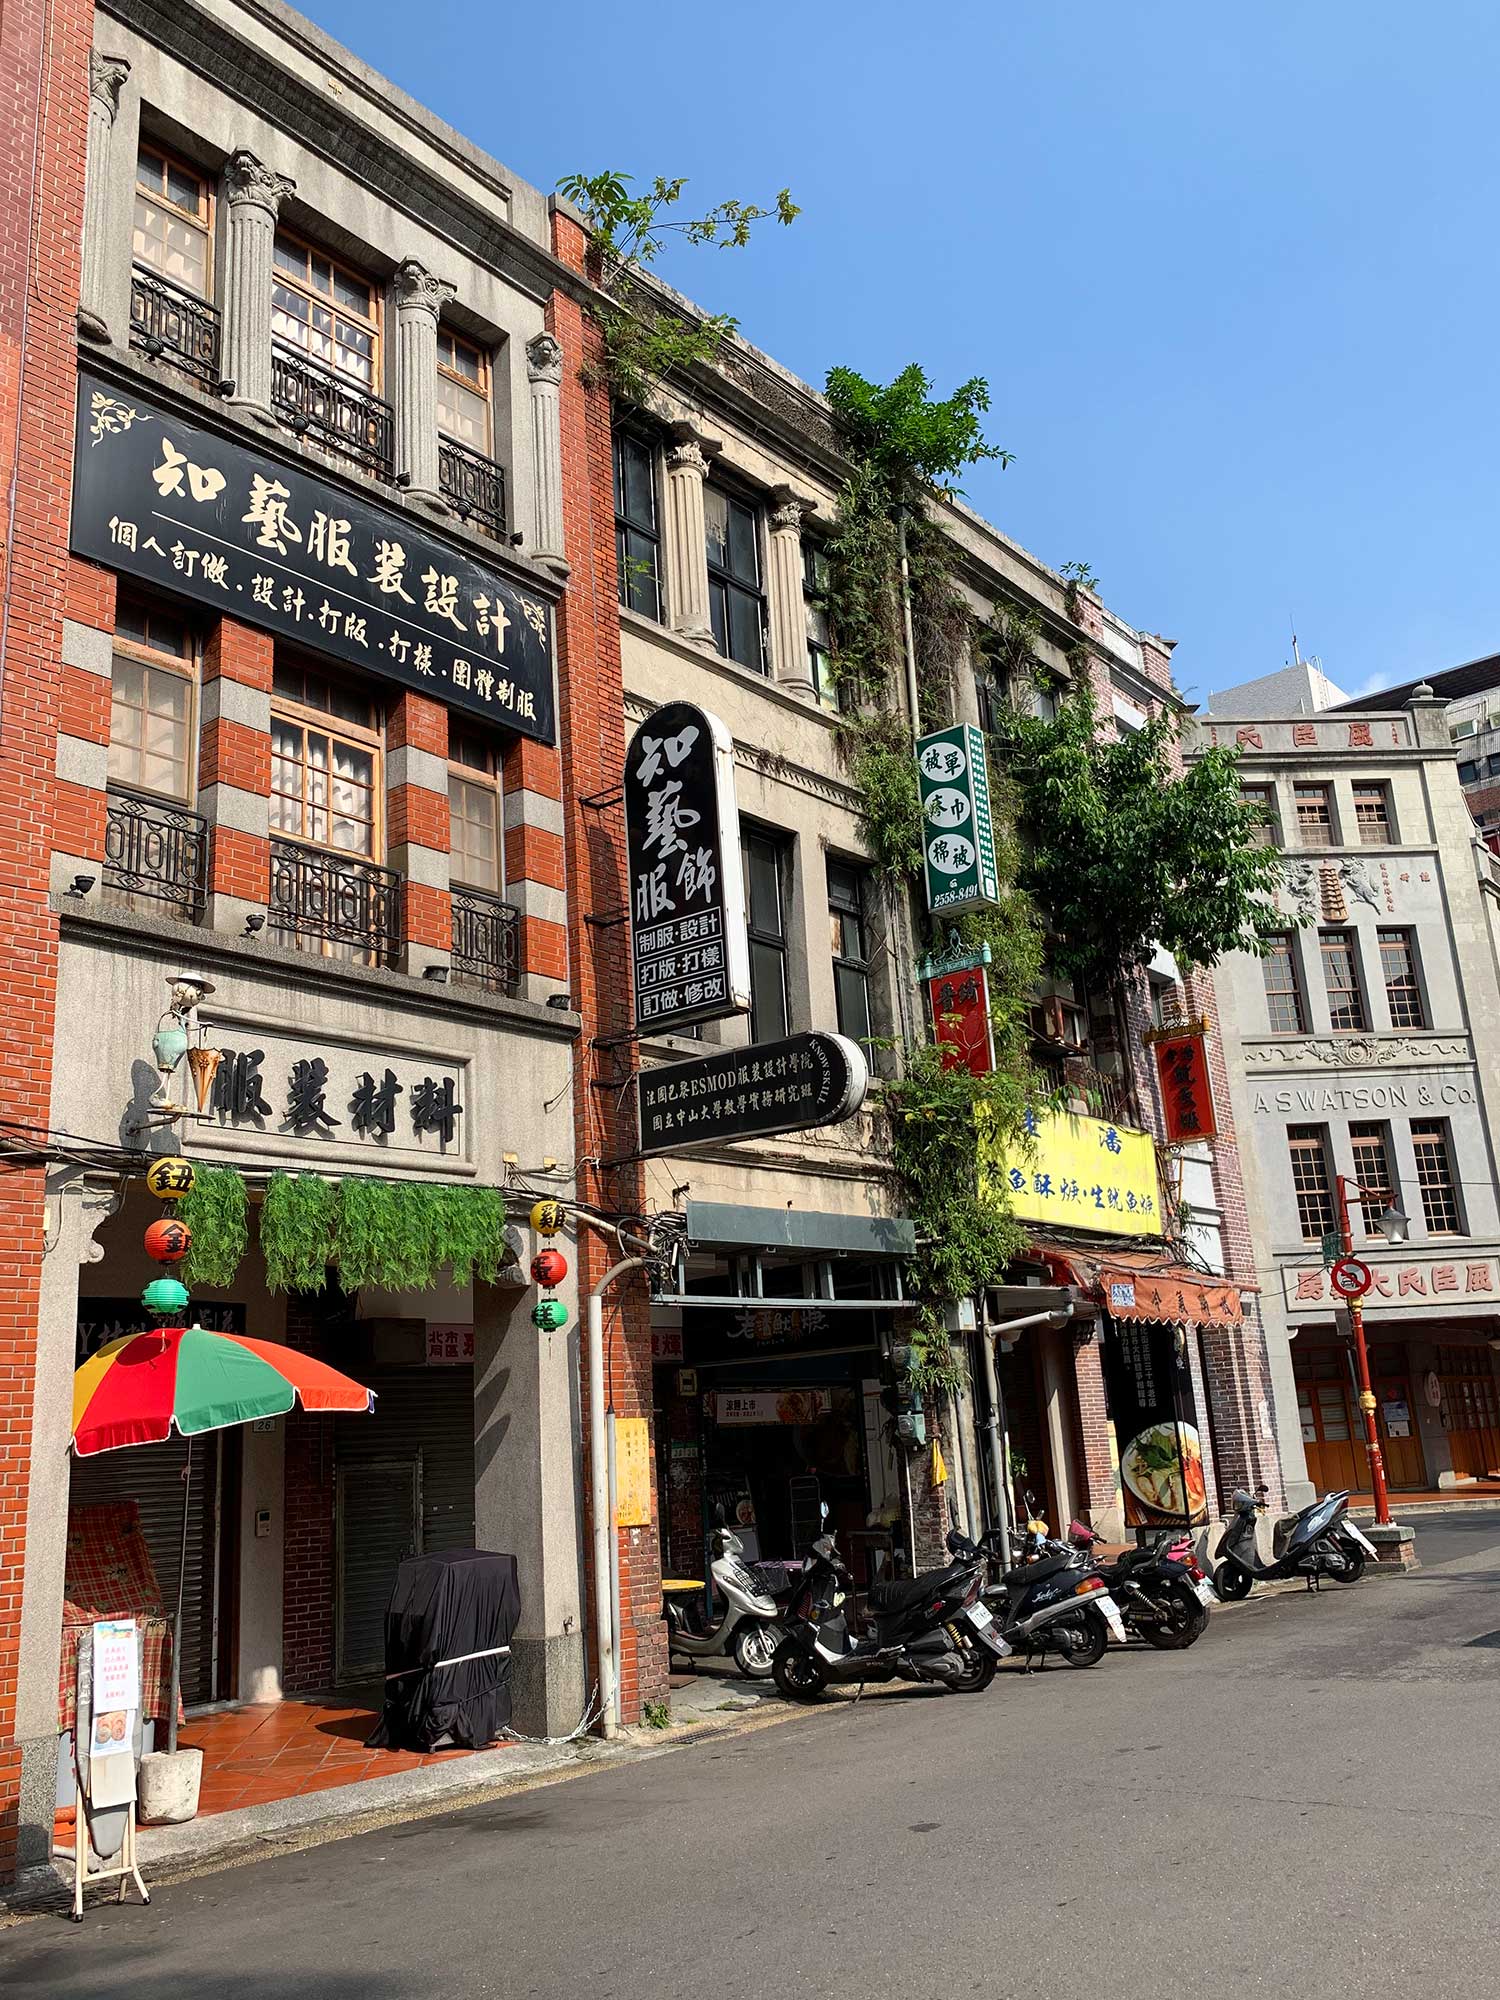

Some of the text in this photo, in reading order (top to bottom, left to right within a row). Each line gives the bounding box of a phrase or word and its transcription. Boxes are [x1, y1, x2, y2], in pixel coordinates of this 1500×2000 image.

[152, 437, 512, 654] 知藝服裝設計
[925, 749, 961, 776] 被單
[933, 840, 971, 868] 棉被
[934, 883, 978, 908] 2558-8491
[212, 1048, 464, 1143] 服裝材料
[151, 1162, 195, 1193] 鈕
[257, 1420, 271, 1430] 26
